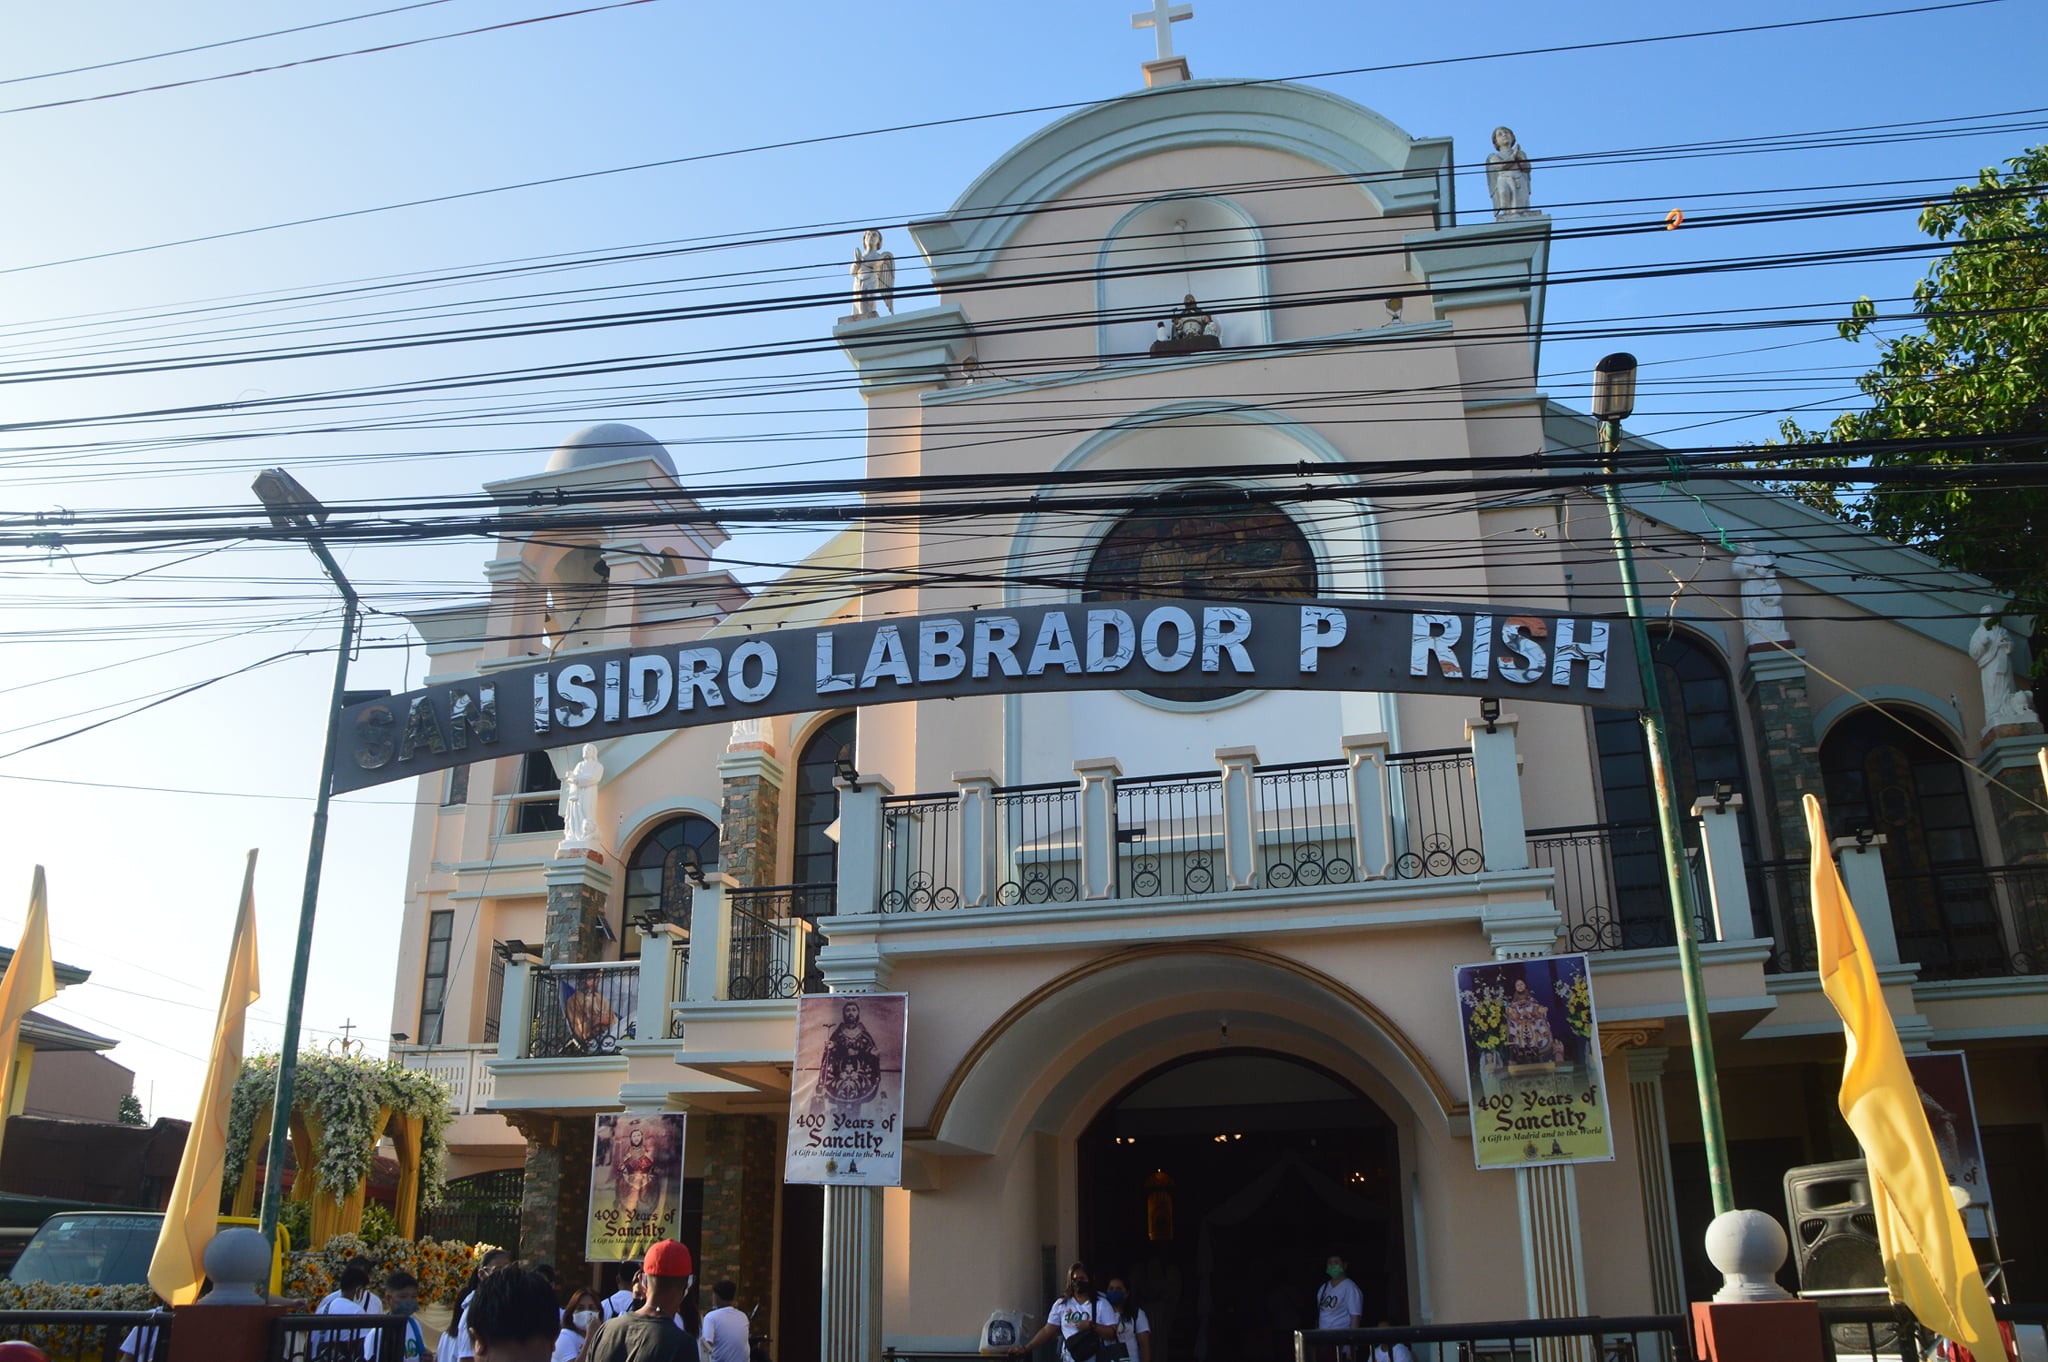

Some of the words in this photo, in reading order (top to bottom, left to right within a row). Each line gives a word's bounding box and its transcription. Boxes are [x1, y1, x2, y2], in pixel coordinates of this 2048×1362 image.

[354, 681, 497, 769] SAN
[533, 640, 779, 733] ISIDRO
[816, 605, 1256, 694] LABRADOR
[1477, 1093, 1514, 1111] 400
[1521, 1091, 1573, 1111] Years
[1581, 1085, 1597, 1107] of
[796, 1114, 826, 1128] 400
[832, 1113, 874, 1131] Years
[882, 1113, 896, 1133] of
[1494, 1106, 1587, 1132] Sanctity
[806, 1128, 883, 1154] Sanctity
[1487, 1134, 1502, 1144] Gift
[1512, 1131, 1540, 1140] Madrid
[1541, 1129, 1556, 1138] and
[1566, 1127, 1578, 1136] the
[1580, 1126, 1602, 1135] World
[819, 1149, 841, 1157] Madrid
[842, 1150, 855, 1158] and
[856, 1150, 863, 1158] to
[863, 1150, 874, 1158] the
[874, 1151, 895, 1159] World
[1964, 1166, 1977, 1185] of
[594, 1208, 620, 1221] 400
[625, 1208, 658, 1223] Years
[664, 1208, 676, 1224] of
[603, 1220, 666, 1241] Sanctity
